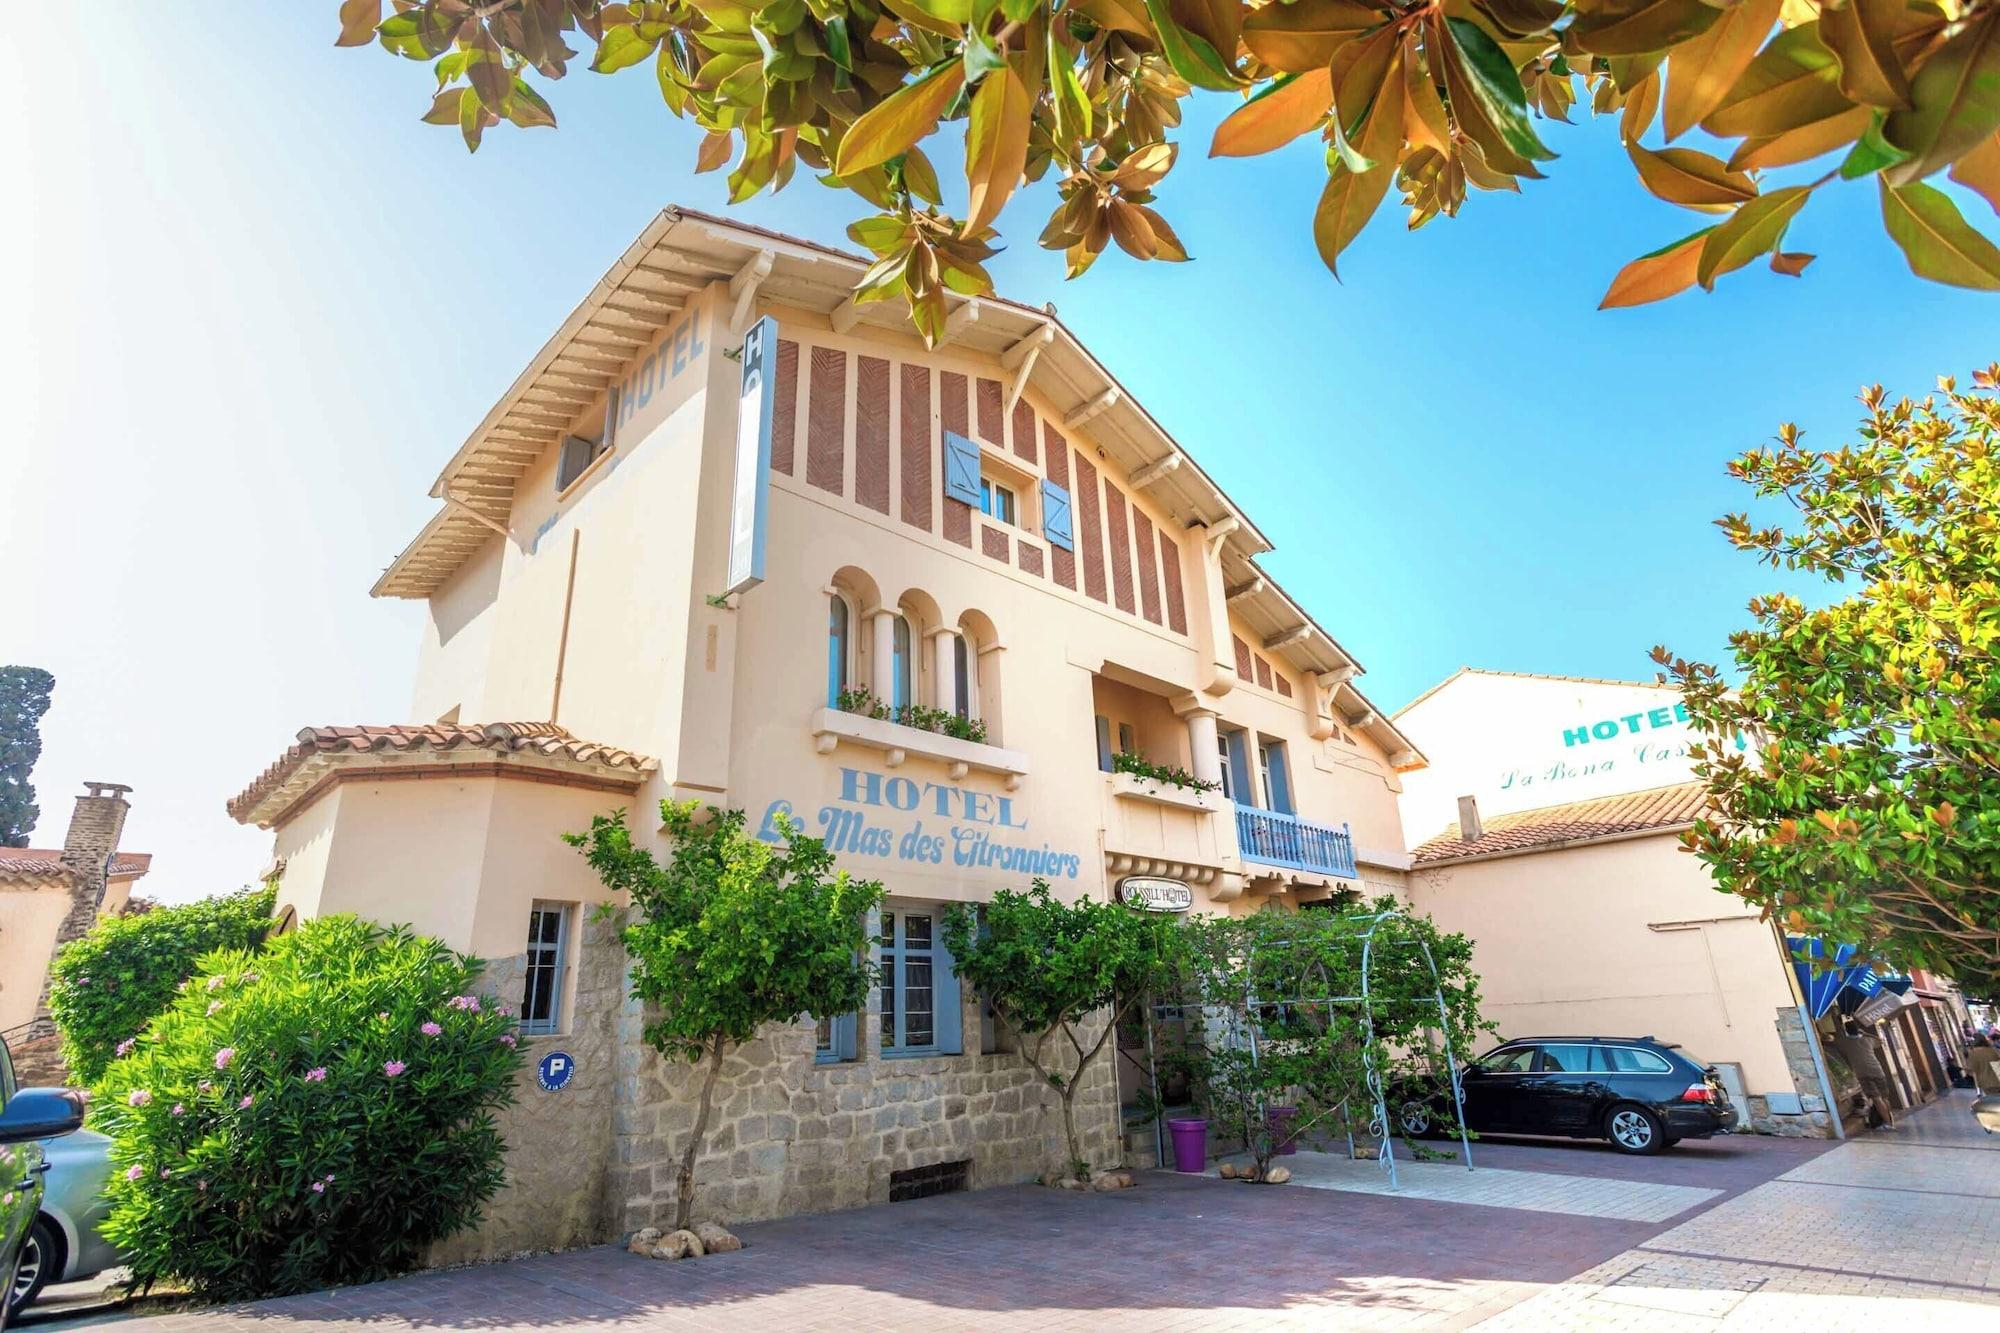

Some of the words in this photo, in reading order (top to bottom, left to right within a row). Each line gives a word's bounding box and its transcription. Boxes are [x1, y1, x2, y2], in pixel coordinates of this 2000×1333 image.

[619, 308, 705, 430] HOTEL
[1563, 703, 1691, 747] HOTEL
[1633, 742, 1685, 763] Cas
[838, 767, 1028, 830] HOTEL
[818, 806, 893, 858] Mas
[899, 820, 945, 864] des
[951, 826, 1081, 879] Citronniers
[550, 1058, 565, 1077] P
